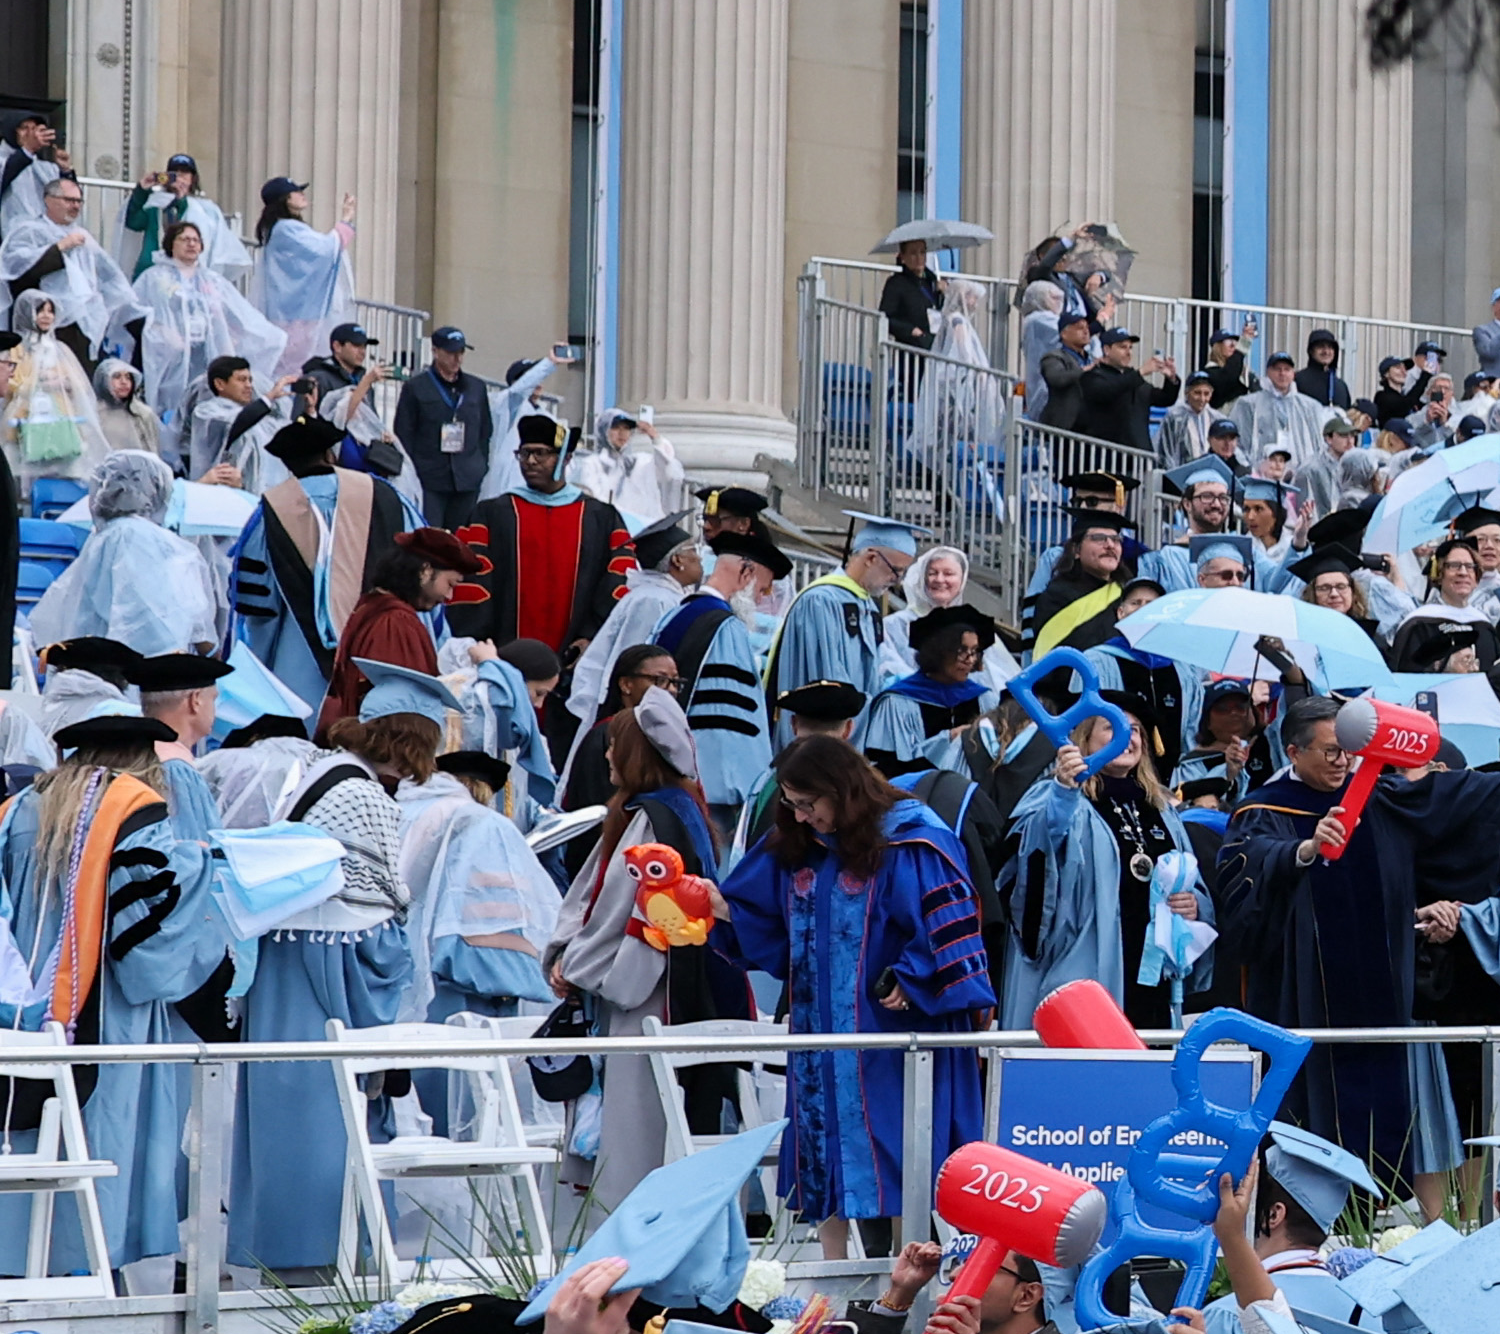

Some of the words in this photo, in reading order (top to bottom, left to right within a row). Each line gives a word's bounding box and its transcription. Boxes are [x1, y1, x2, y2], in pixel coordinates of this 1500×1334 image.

[1383, 728, 1429, 754] 2025
[1011, 1125, 1084, 1146] School
[1089, 1125, 1112, 1146] of
[1116, 1125, 1229, 1150] Eneerin
[1061, 1161, 1127, 1183] Applie
[961, 1163, 1051, 1214] 2025
[950, 1235, 979, 1253] 202
